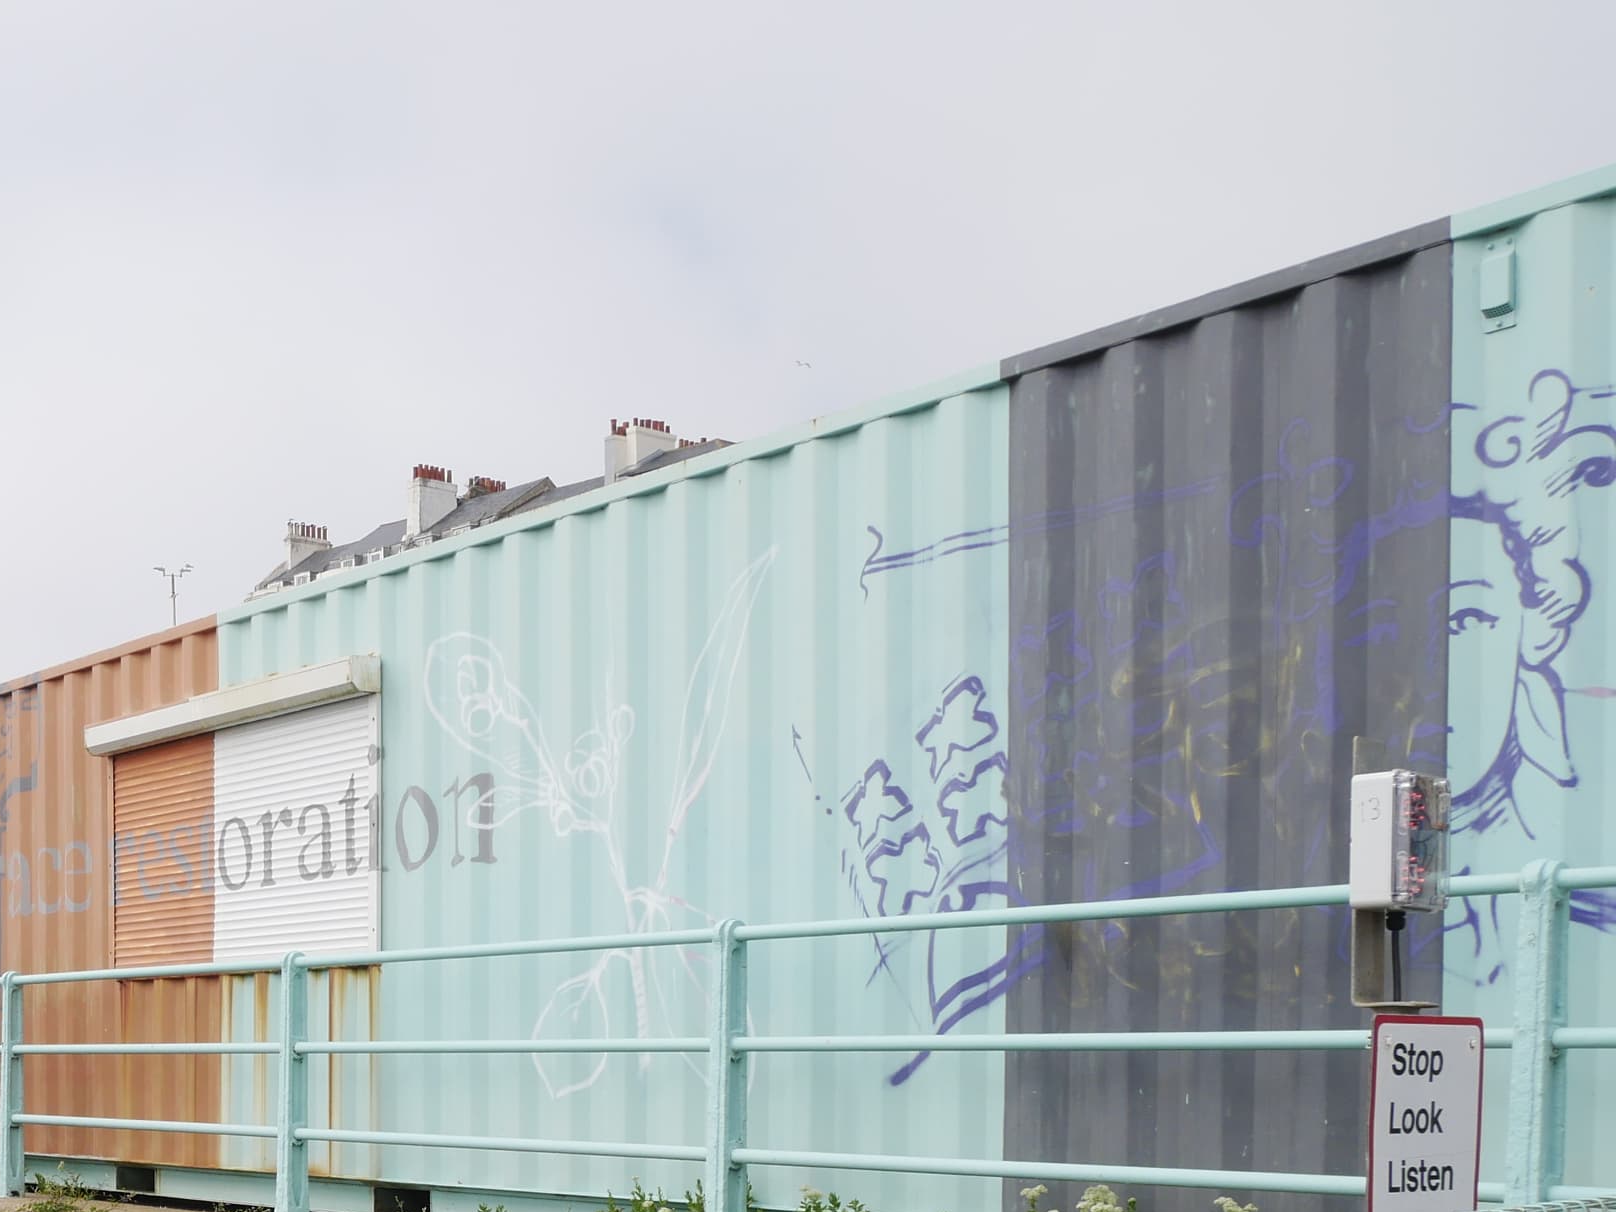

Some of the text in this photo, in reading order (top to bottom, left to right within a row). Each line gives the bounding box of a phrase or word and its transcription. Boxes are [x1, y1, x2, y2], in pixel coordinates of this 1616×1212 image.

[109, 743, 499, 906] restoration
[1392, 1043, 1444, 1082] Stop
[1389, 1101, 1444, 1135] Look
[1388, 1160, 1454, 1193] Listen
